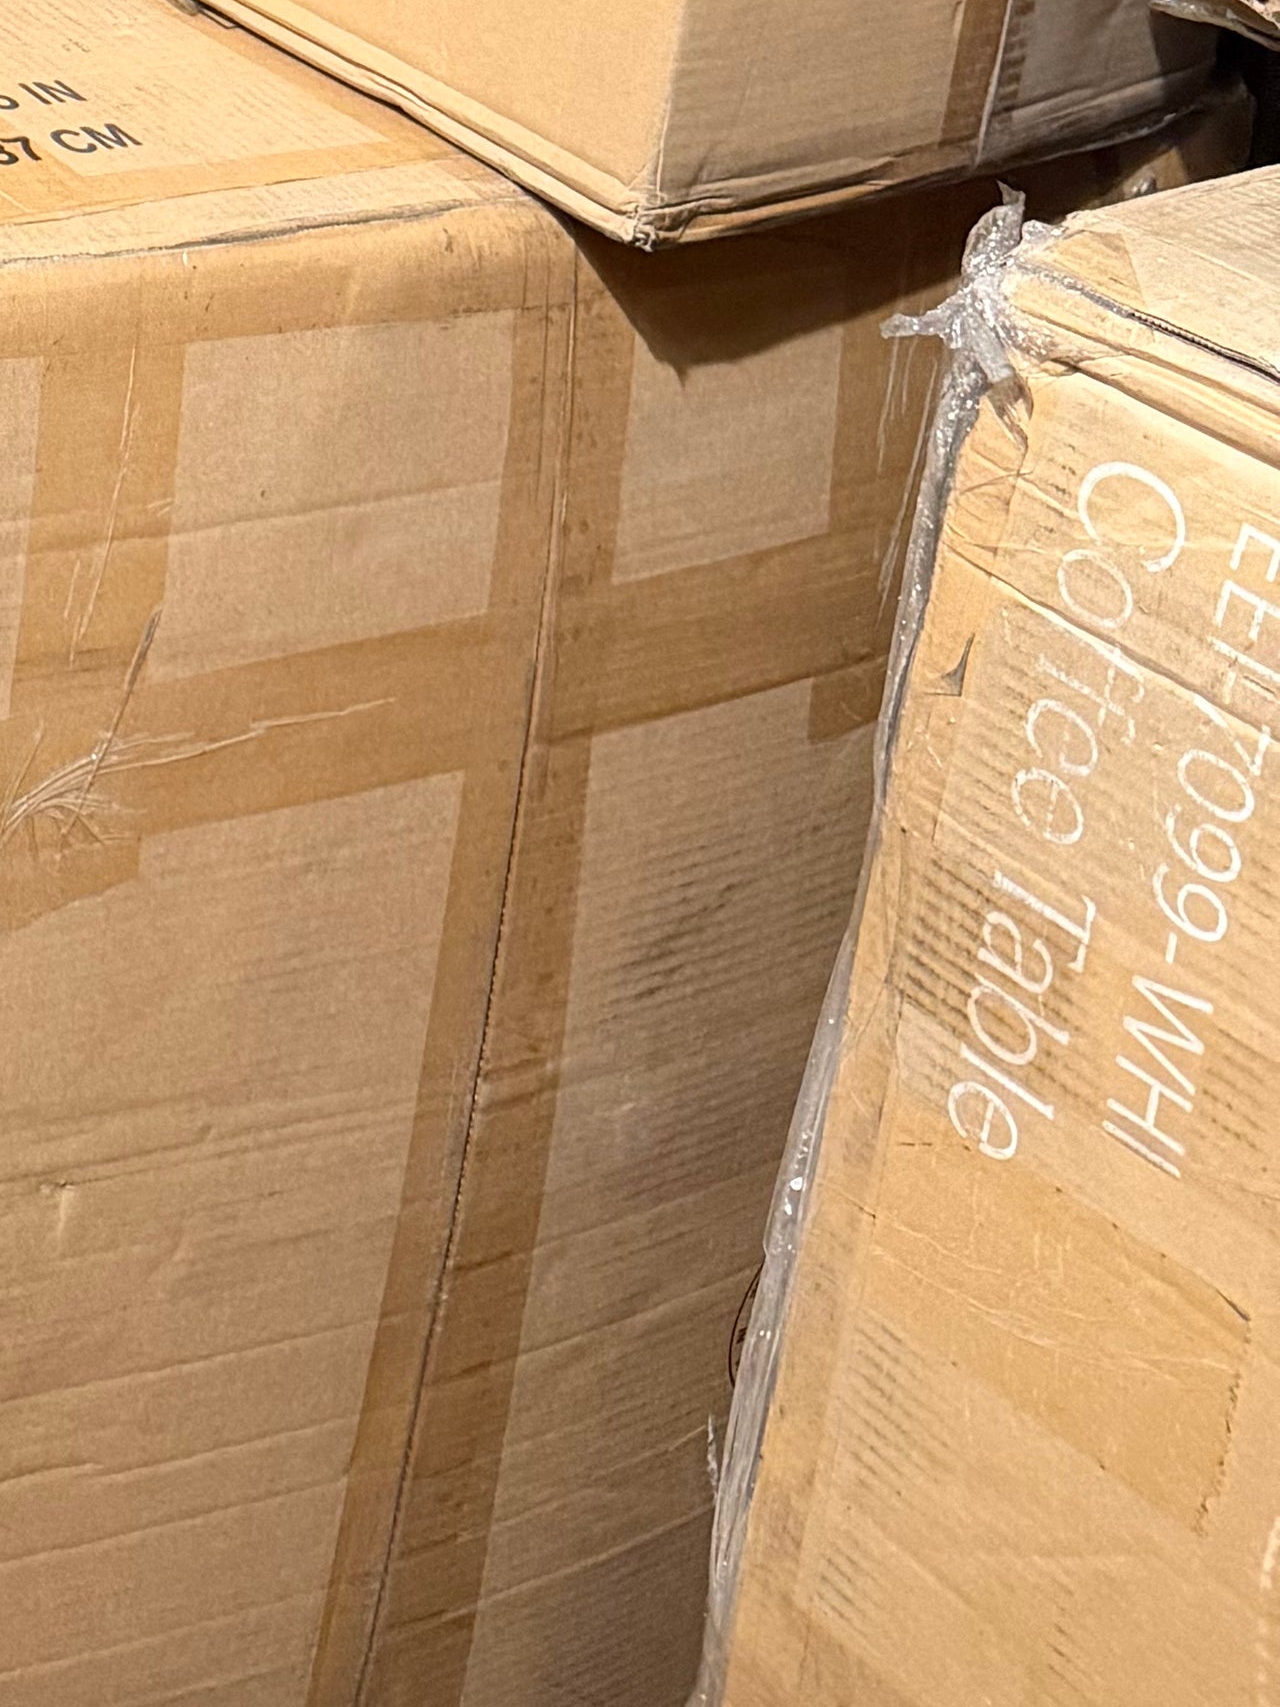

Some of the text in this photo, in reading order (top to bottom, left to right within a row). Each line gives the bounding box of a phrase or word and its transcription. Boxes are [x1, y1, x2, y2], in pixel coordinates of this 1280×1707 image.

[18, 78, 89, 106] IN
[49, 122, 144, 154] CM
[946, 869, 1098, 1162] Table
